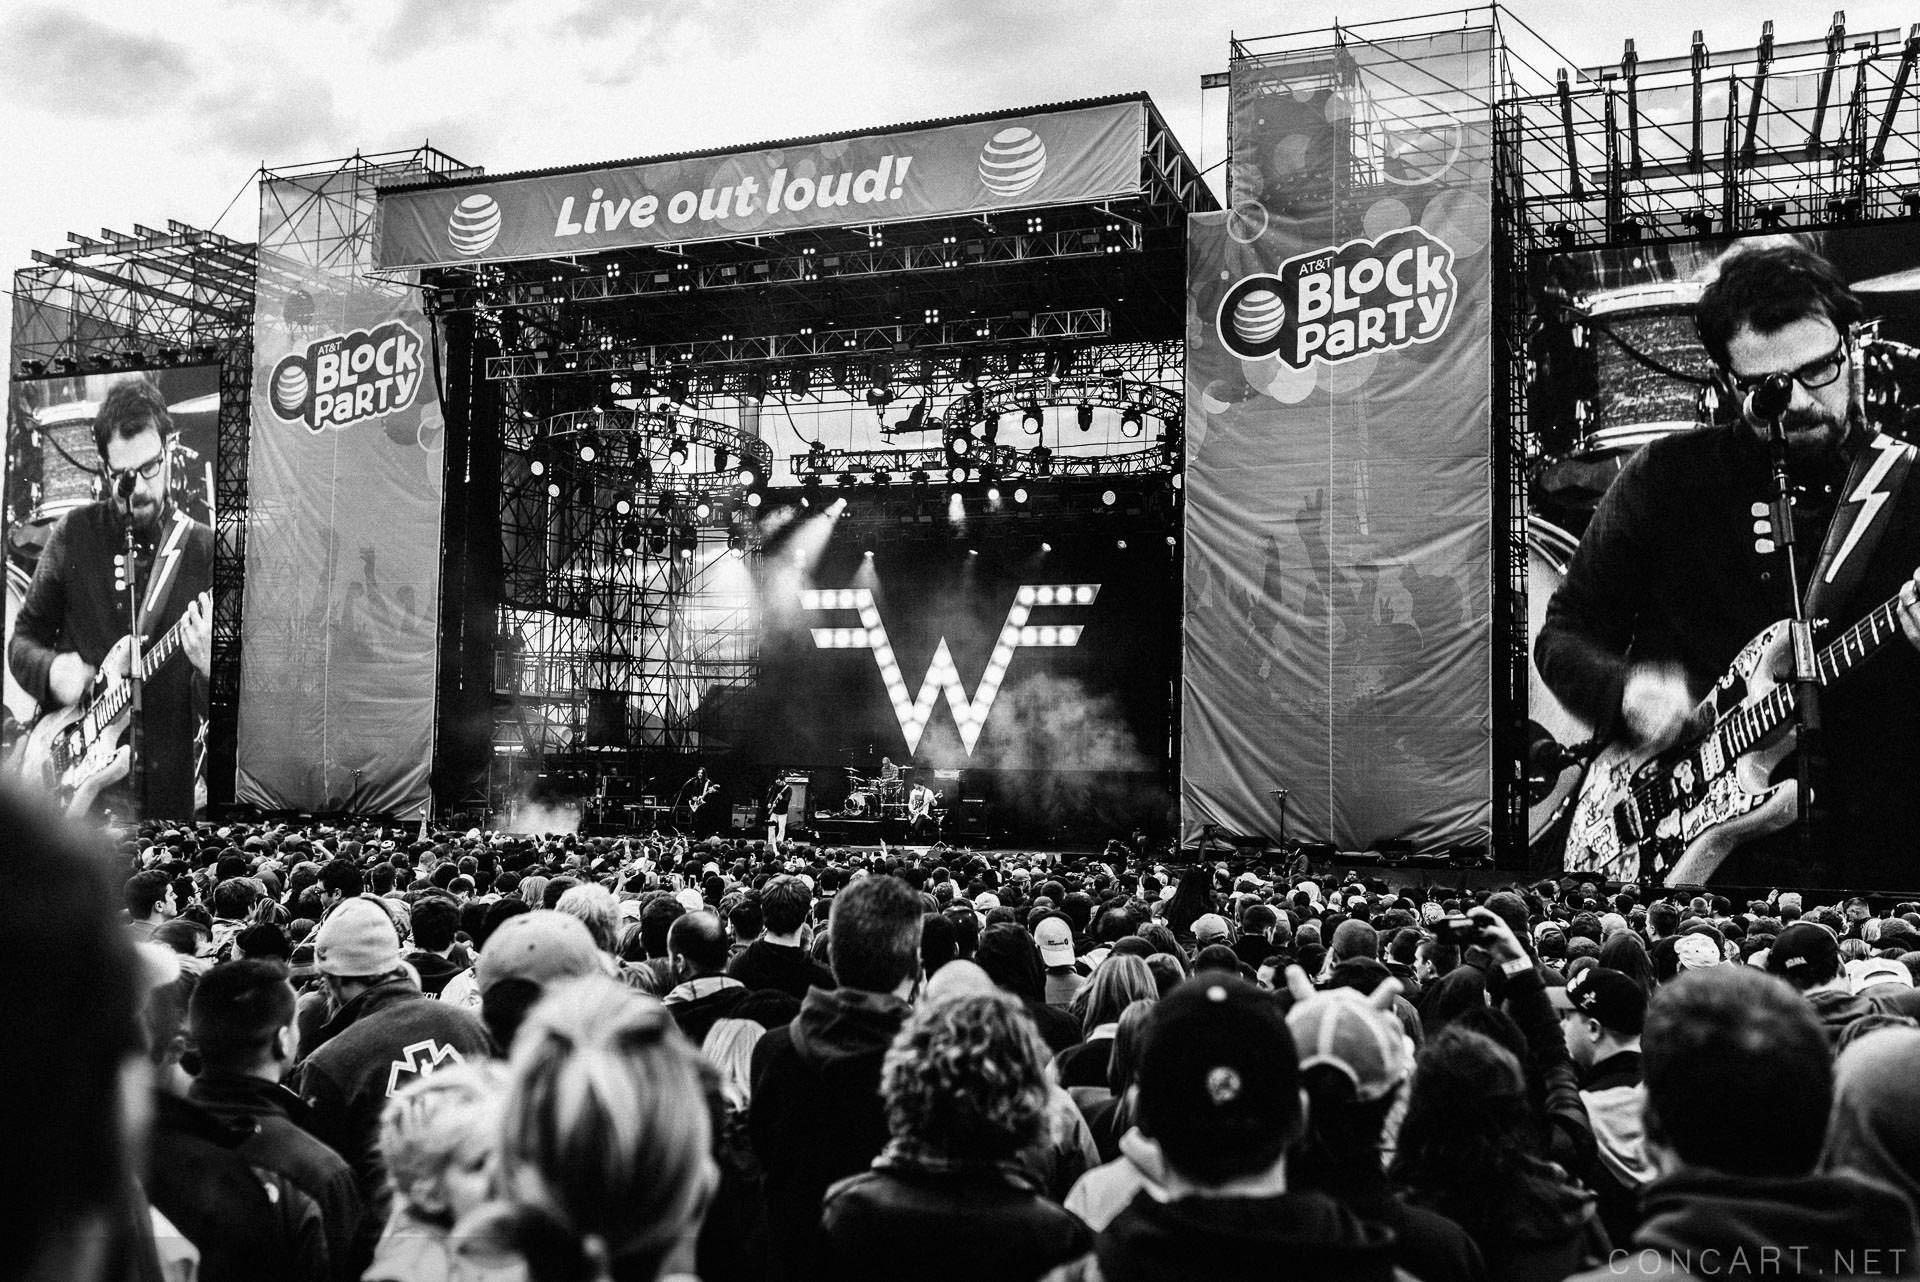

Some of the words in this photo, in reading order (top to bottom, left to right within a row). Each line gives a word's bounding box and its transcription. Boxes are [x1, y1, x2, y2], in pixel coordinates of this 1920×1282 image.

[554, 187, 659, 237] Live
[667, 176, 760, 224] out
[766, 155, 913, 214] loud!
[1299, 256, 1334, 276] AT&T
[317, 340, 343, 356] AT&T
